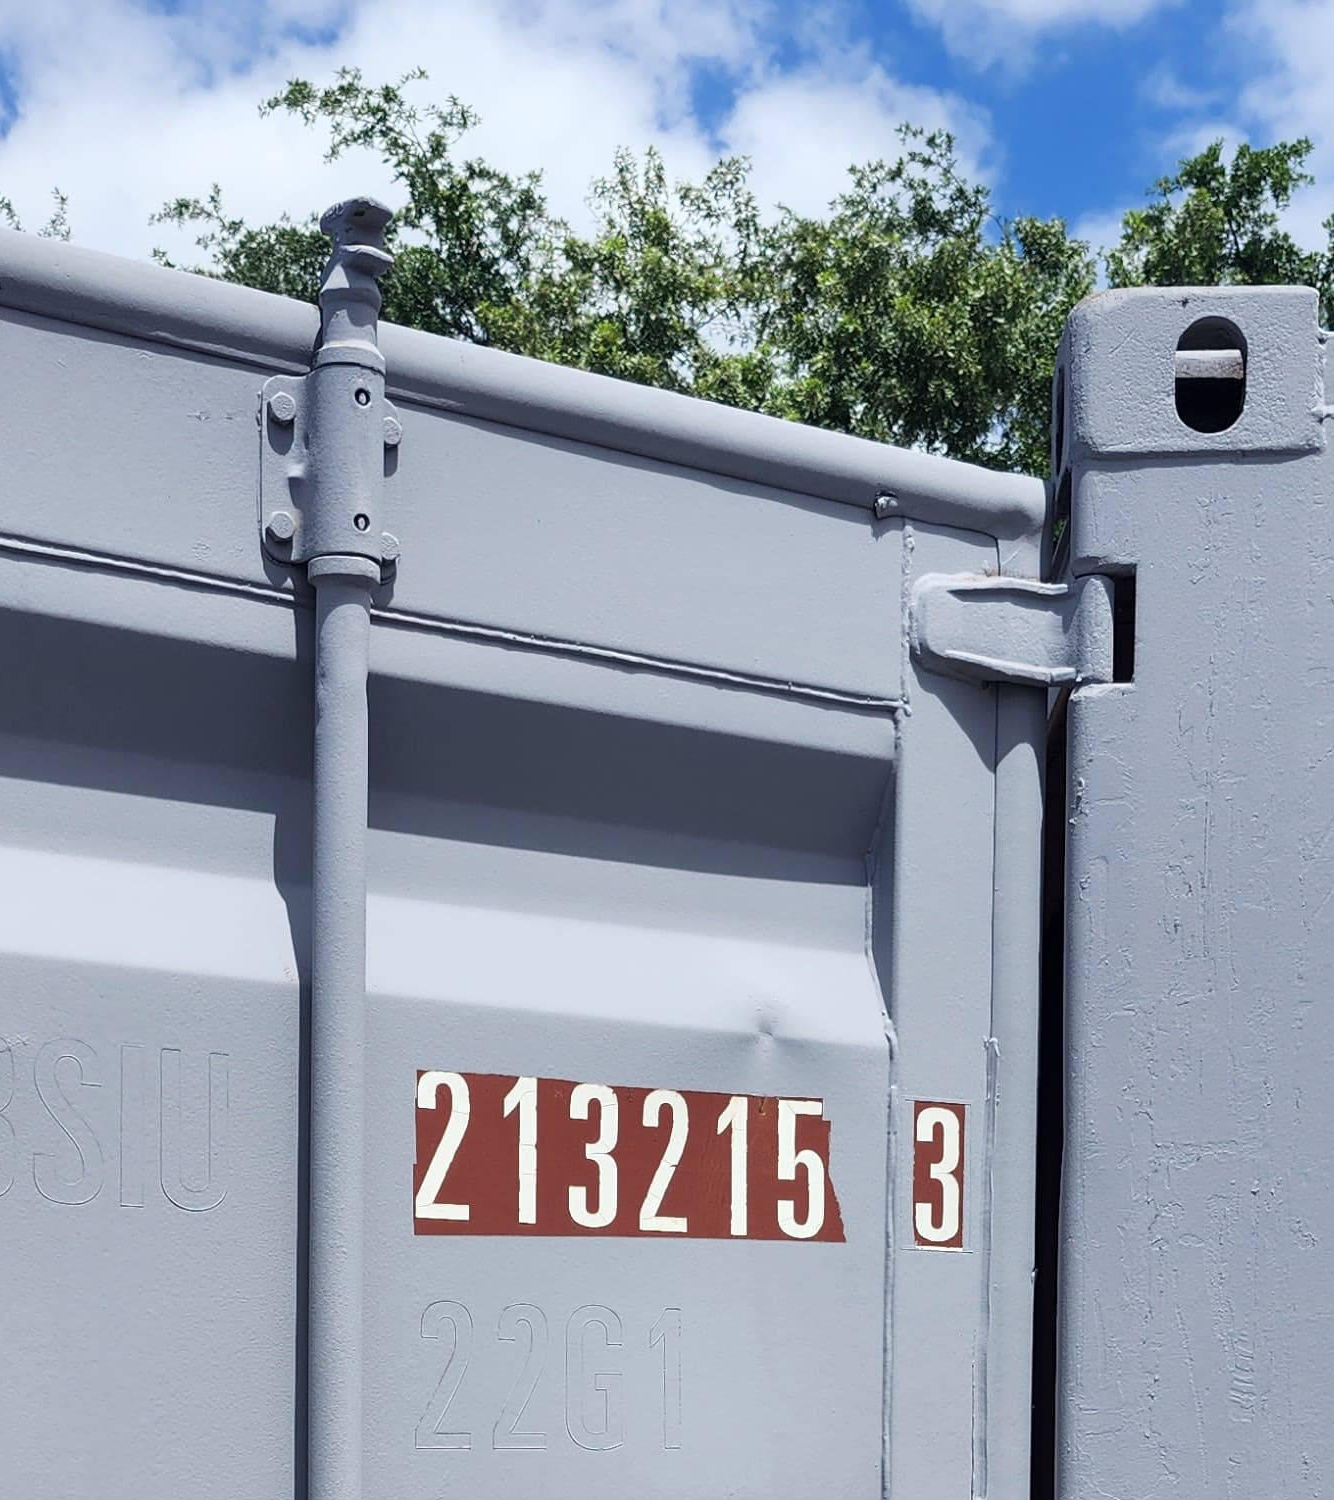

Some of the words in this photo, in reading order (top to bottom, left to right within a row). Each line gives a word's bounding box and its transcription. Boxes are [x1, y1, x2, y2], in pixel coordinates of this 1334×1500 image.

[415, 1070, 825, 1239] 213215
[914, 1106, 961, 1243] 3
[414, 1299, 682, 1451] 22G1
